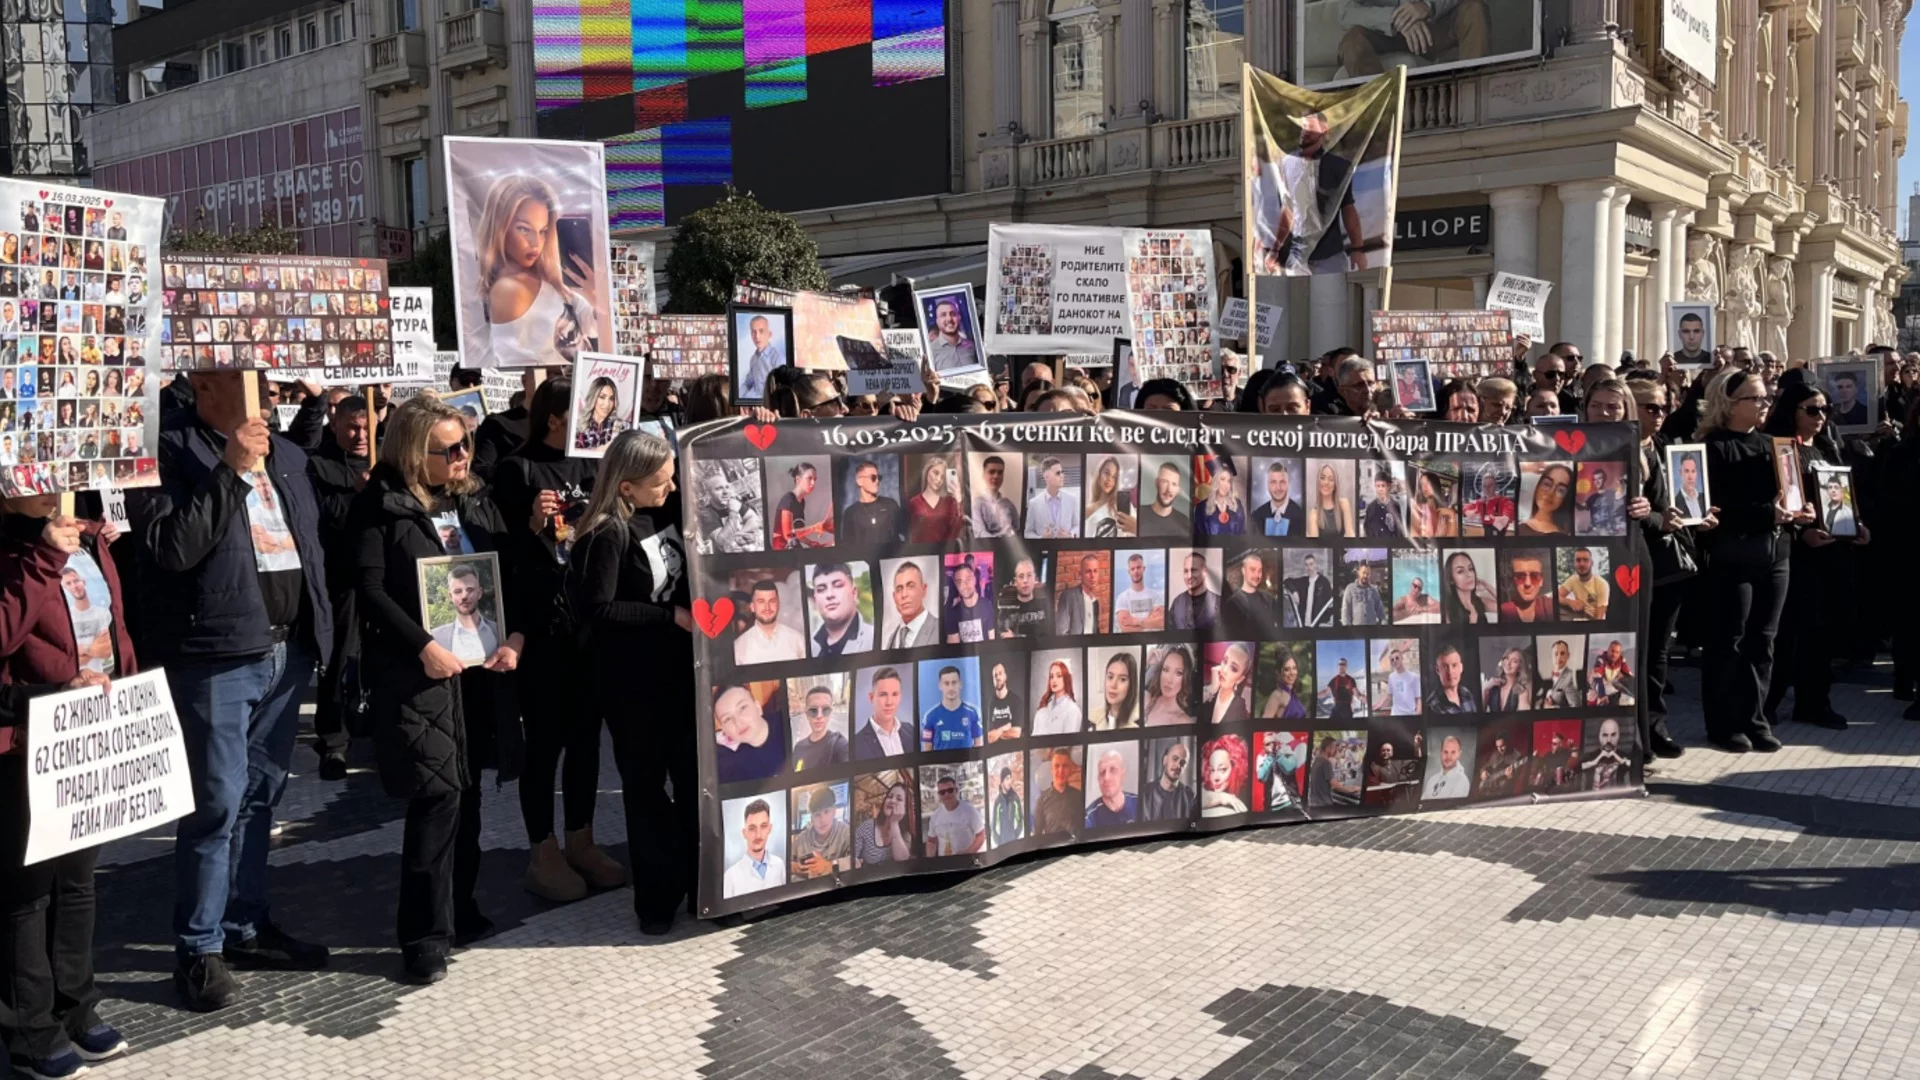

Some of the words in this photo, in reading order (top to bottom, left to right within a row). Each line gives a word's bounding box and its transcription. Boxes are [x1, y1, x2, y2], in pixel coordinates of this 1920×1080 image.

[204, 179, 266, 211] OFFICE
[273, 166, 334, 198] SPACE
[340, 160, 364, 188] FO
[51, 191, 102, 206] 16.03.2025
[312, 198, 342, 225] 389
[349, 194, 364, 220] 71
[1394, 215, 1481, 239] LLIOPE
[1084, 246, 1105, 256] НИЕ
[1060, 260, 1125, 272] РОДИТЕЛИТЕ
[1075, 277, 1109, 288] СКАПО
[405, 296, 423, 312] ДА
[1056, 293, 1070, 303] ГО
[1072, 293, 1125, 304] ПЛАТИВМЕ
[1058, 309, 1104, 320] ДАНОКОТ
[1107, 309, 1121, 320] НА
[1053, 325, 1124, 337] КОРУПЦИЈАТА
[393, 340, 412, 354] ТЕ
[407, 363, 418, 376] !!!
[820, 424, 955, 448] 16.03.2025
[980, 420, 1005, 444] 63
[1012, 424, 1083, 443] сенки
[1120, 426, 1145, 444] ве
[1150, 426, 1225, 449] следат
[1247, 424, 1303, 451] секој
[1309, 431, 1380, 453] поглед
[1384, 429, 1429, 454] бара
[1435, 432, 1529, 454] ПРАВДА
[53, 703, 67, 732] 62
[69, 694, 112, 730] ЖИВОТИ
[117, 690, 129, 717] 62
[35, 745, 50, 775] 62
[52, 730, 110, 771] СЕМЕЈСТВА
[112, 727, 124, 755] СО
[125, 718, 153, 752] ВЕЧНА
[56, 769, 100, 808] ПРАВДА
[102, 767, 110, 795] И
[111, 748, 172, 797] ОДГОВОРНОСТ
[70, 805, 101, 841] НЕМА
[103, 798, 127, 831] МИР
[129, 791, 146, 823] БЕЗ
